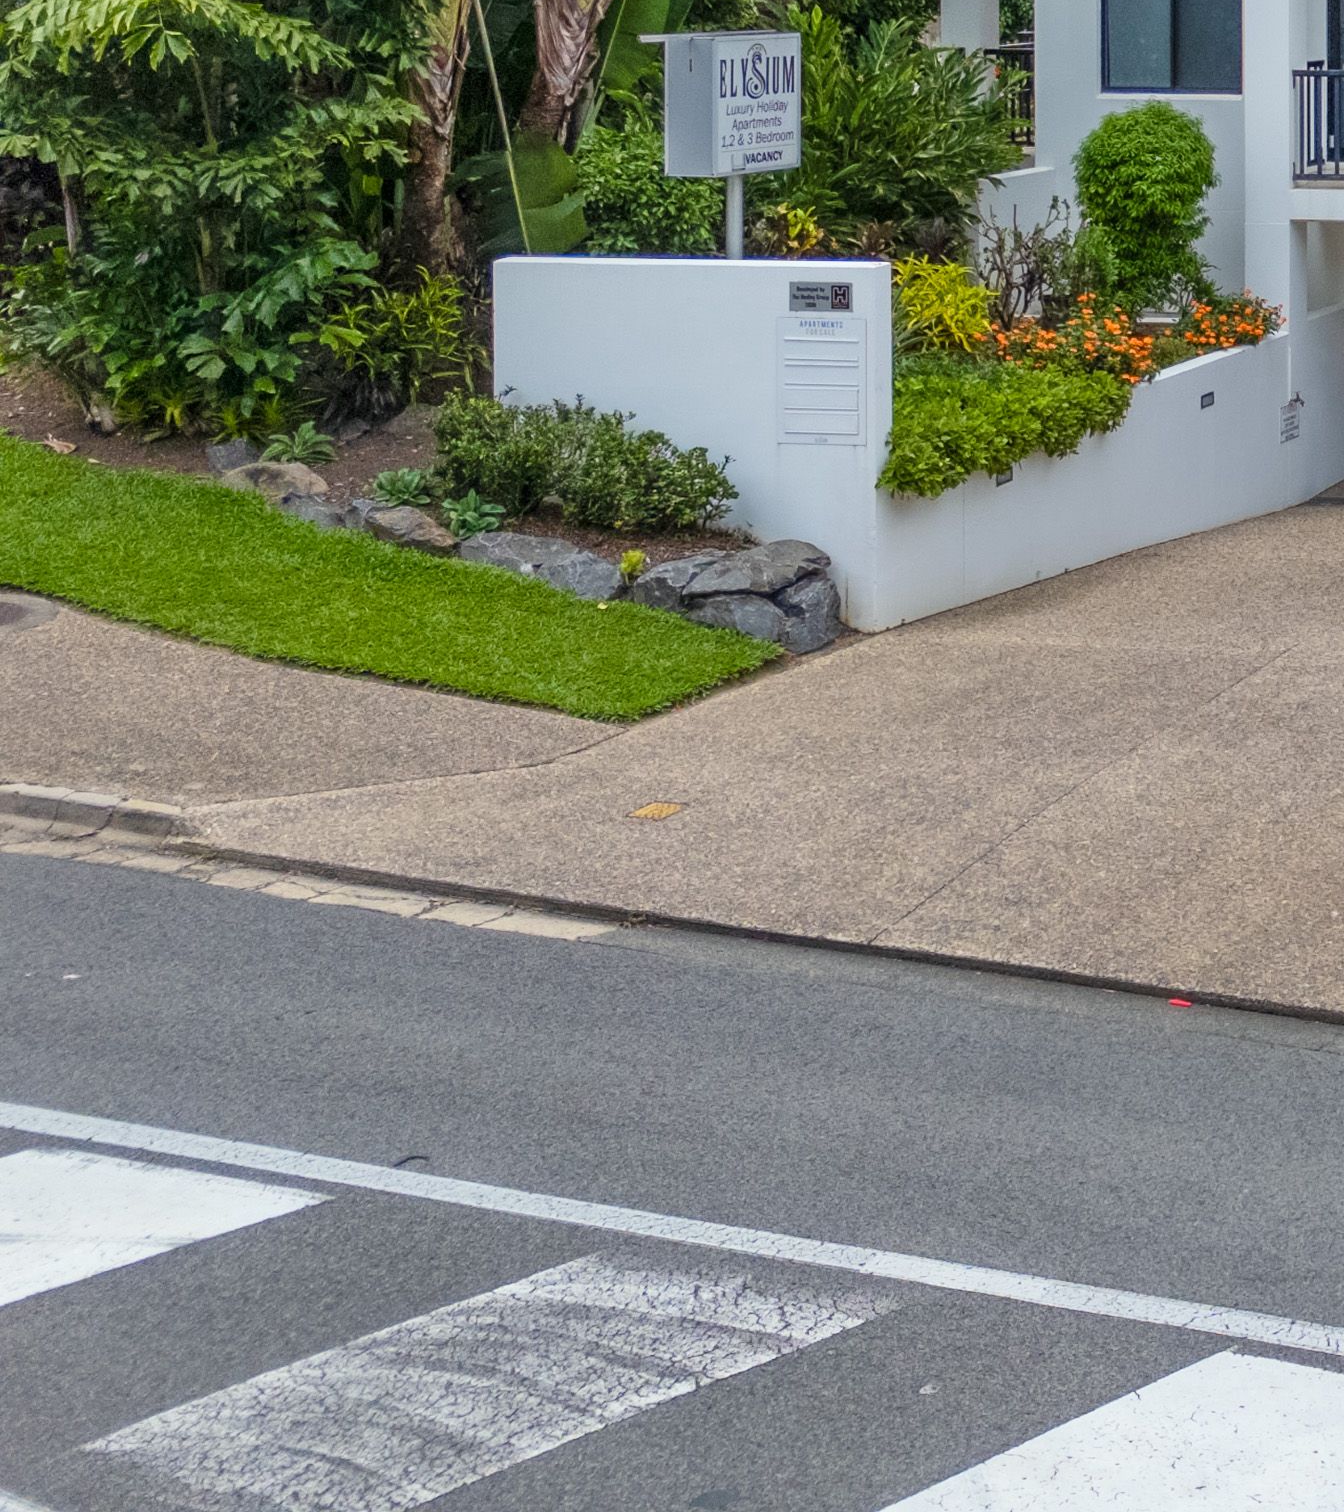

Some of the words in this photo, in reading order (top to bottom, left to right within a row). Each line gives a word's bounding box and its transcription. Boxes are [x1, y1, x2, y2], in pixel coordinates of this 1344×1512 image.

[720, 53, 795, 99] ELYSIUM
[726, 103, 754, 116] Luxury
[757, 100, 788, 113] Holiday
[732, 116, 782, 132] Apartments
[737, 133, 745, 146] &
[747, 132, 754, 145] 3
[755, 130, 794, 144] Bedroom
[745, 150, 783, 164] VACANCY
[800, 320, 843, 328] APARTMENTS
